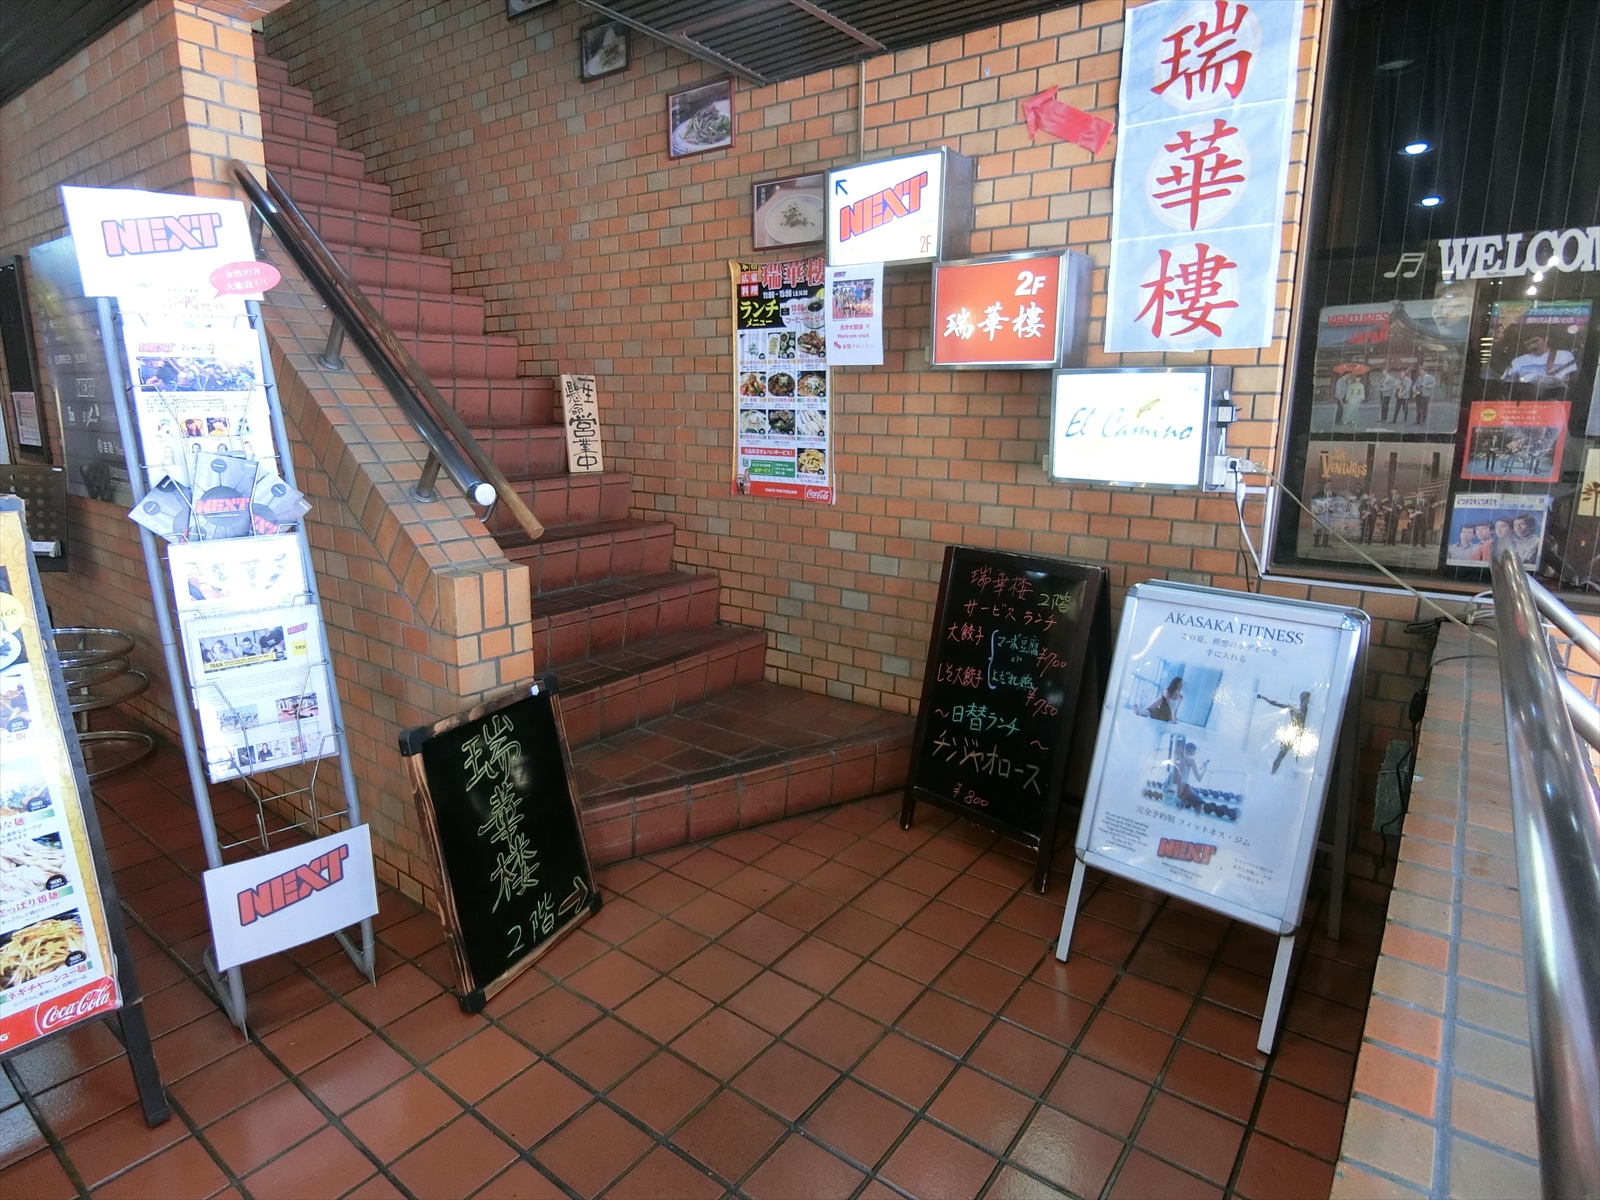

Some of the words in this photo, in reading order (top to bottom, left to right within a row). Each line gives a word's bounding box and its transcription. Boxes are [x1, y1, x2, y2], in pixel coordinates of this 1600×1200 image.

[840, 171, 928, 242] NEXT
[101, 212, 222, 257] NEXT
[920, 235, 931, 253] 2F
[225, 266, 261, 279] 女性の方
[1014, 270, 1046, 296] 2F
[739, 299, 779, 319] ランチ
[745, 319, 773, 327] メニュー
[1065, 407, 1096, 438] El
[1102, 408, 1193, 440] Camino
[195, 497, 250, 515] NEXT
[1038, 592, 1071, 613] 2階
[1164, 612, 1234, 634] AKASAKA
[1239, 623, 1304, 646] FITNESS
[209, 661, 224, 669] TRAIN
[1205, 649, 1246, 663] 手に入れる
[1135, 805, 1176, 824] 完全予約制
[1179, 818, 1250, 847] フィットネス・ジム
[1157, 837, 1217, 865] NEXT
[237, 843, 349, 926] NEXT
[507, 892, 555, 958] 2階
[8, 964, 87, 1000] ネギチャーシュー麺
[42, 984, 112, 1029] Coca-Cola
